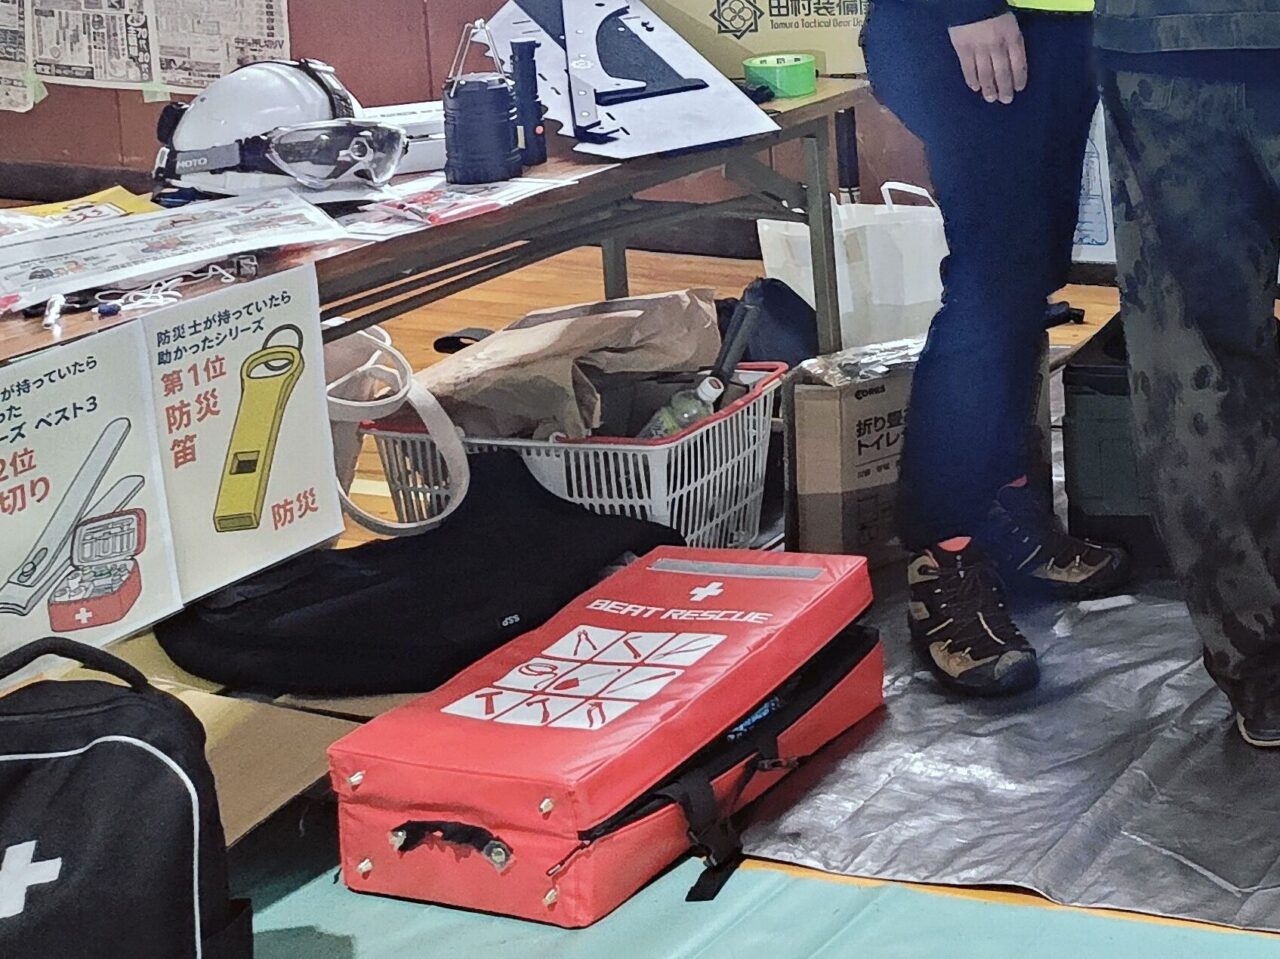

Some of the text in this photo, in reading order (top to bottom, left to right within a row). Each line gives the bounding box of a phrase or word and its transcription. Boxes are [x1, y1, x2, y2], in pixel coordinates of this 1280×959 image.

[156, 290, 292, 347] 防災士が持っていたら
[157, 317, 265, 366] 助かったシリーズ
[160, 355, 228, 397] 第1位
[34, 395, 98, 430] ベスト3
[164, 388, 221, 434] 防災
[856, 407, 910, 439] 折り畳
[170, 434, 198, 470] 笛
[271, 487, 320, 531] 防災
[585, 599, 775, 624] BEAT RESCUE
